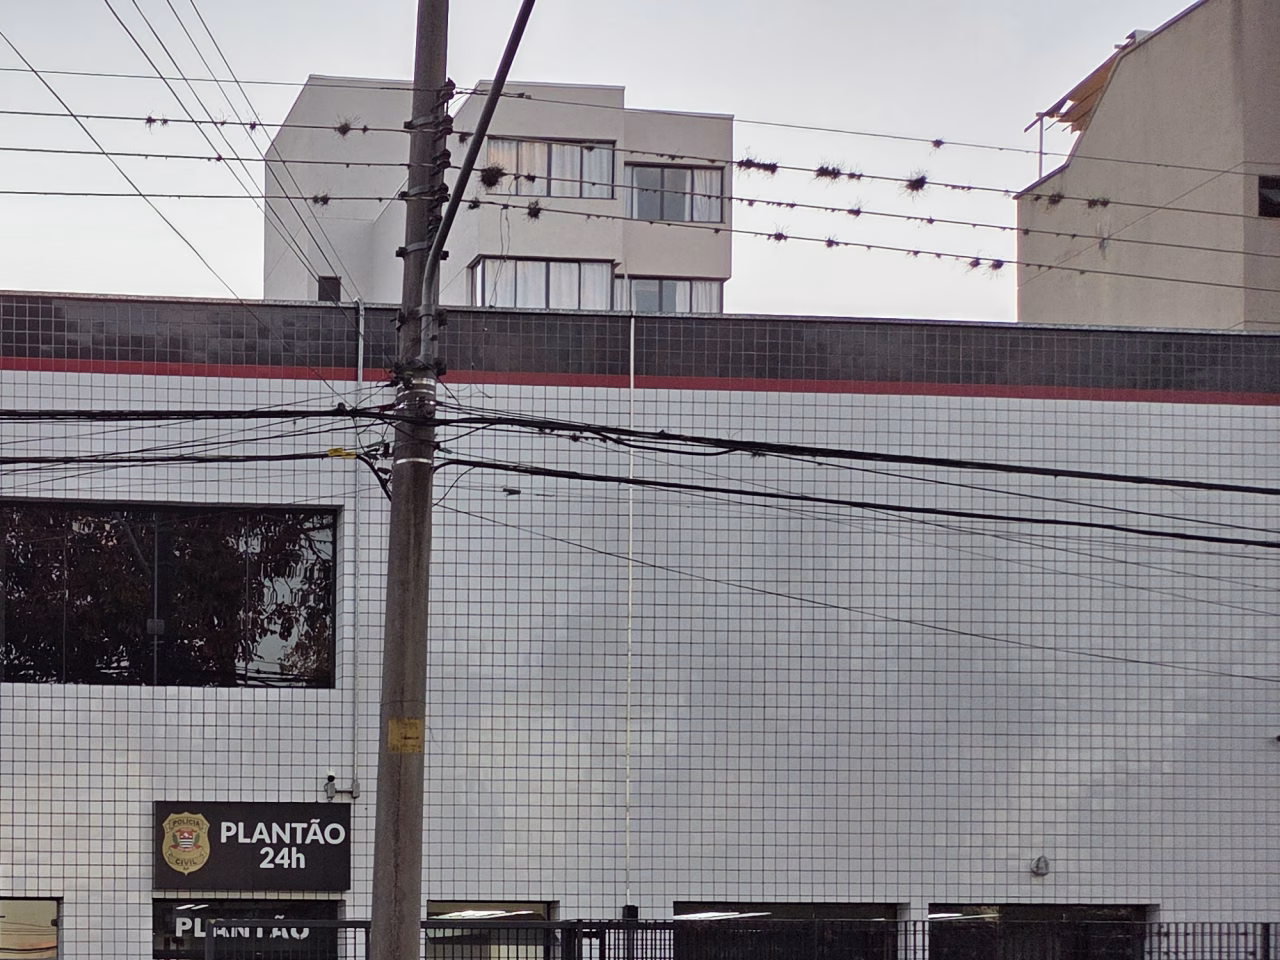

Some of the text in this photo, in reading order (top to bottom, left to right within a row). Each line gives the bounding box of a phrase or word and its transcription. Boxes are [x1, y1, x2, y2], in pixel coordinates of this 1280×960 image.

[220, 818, 346, 845] PLANTÃO
[175, 858, 198, 866] CIVIL
[259, 847, 306, 869] 24h
